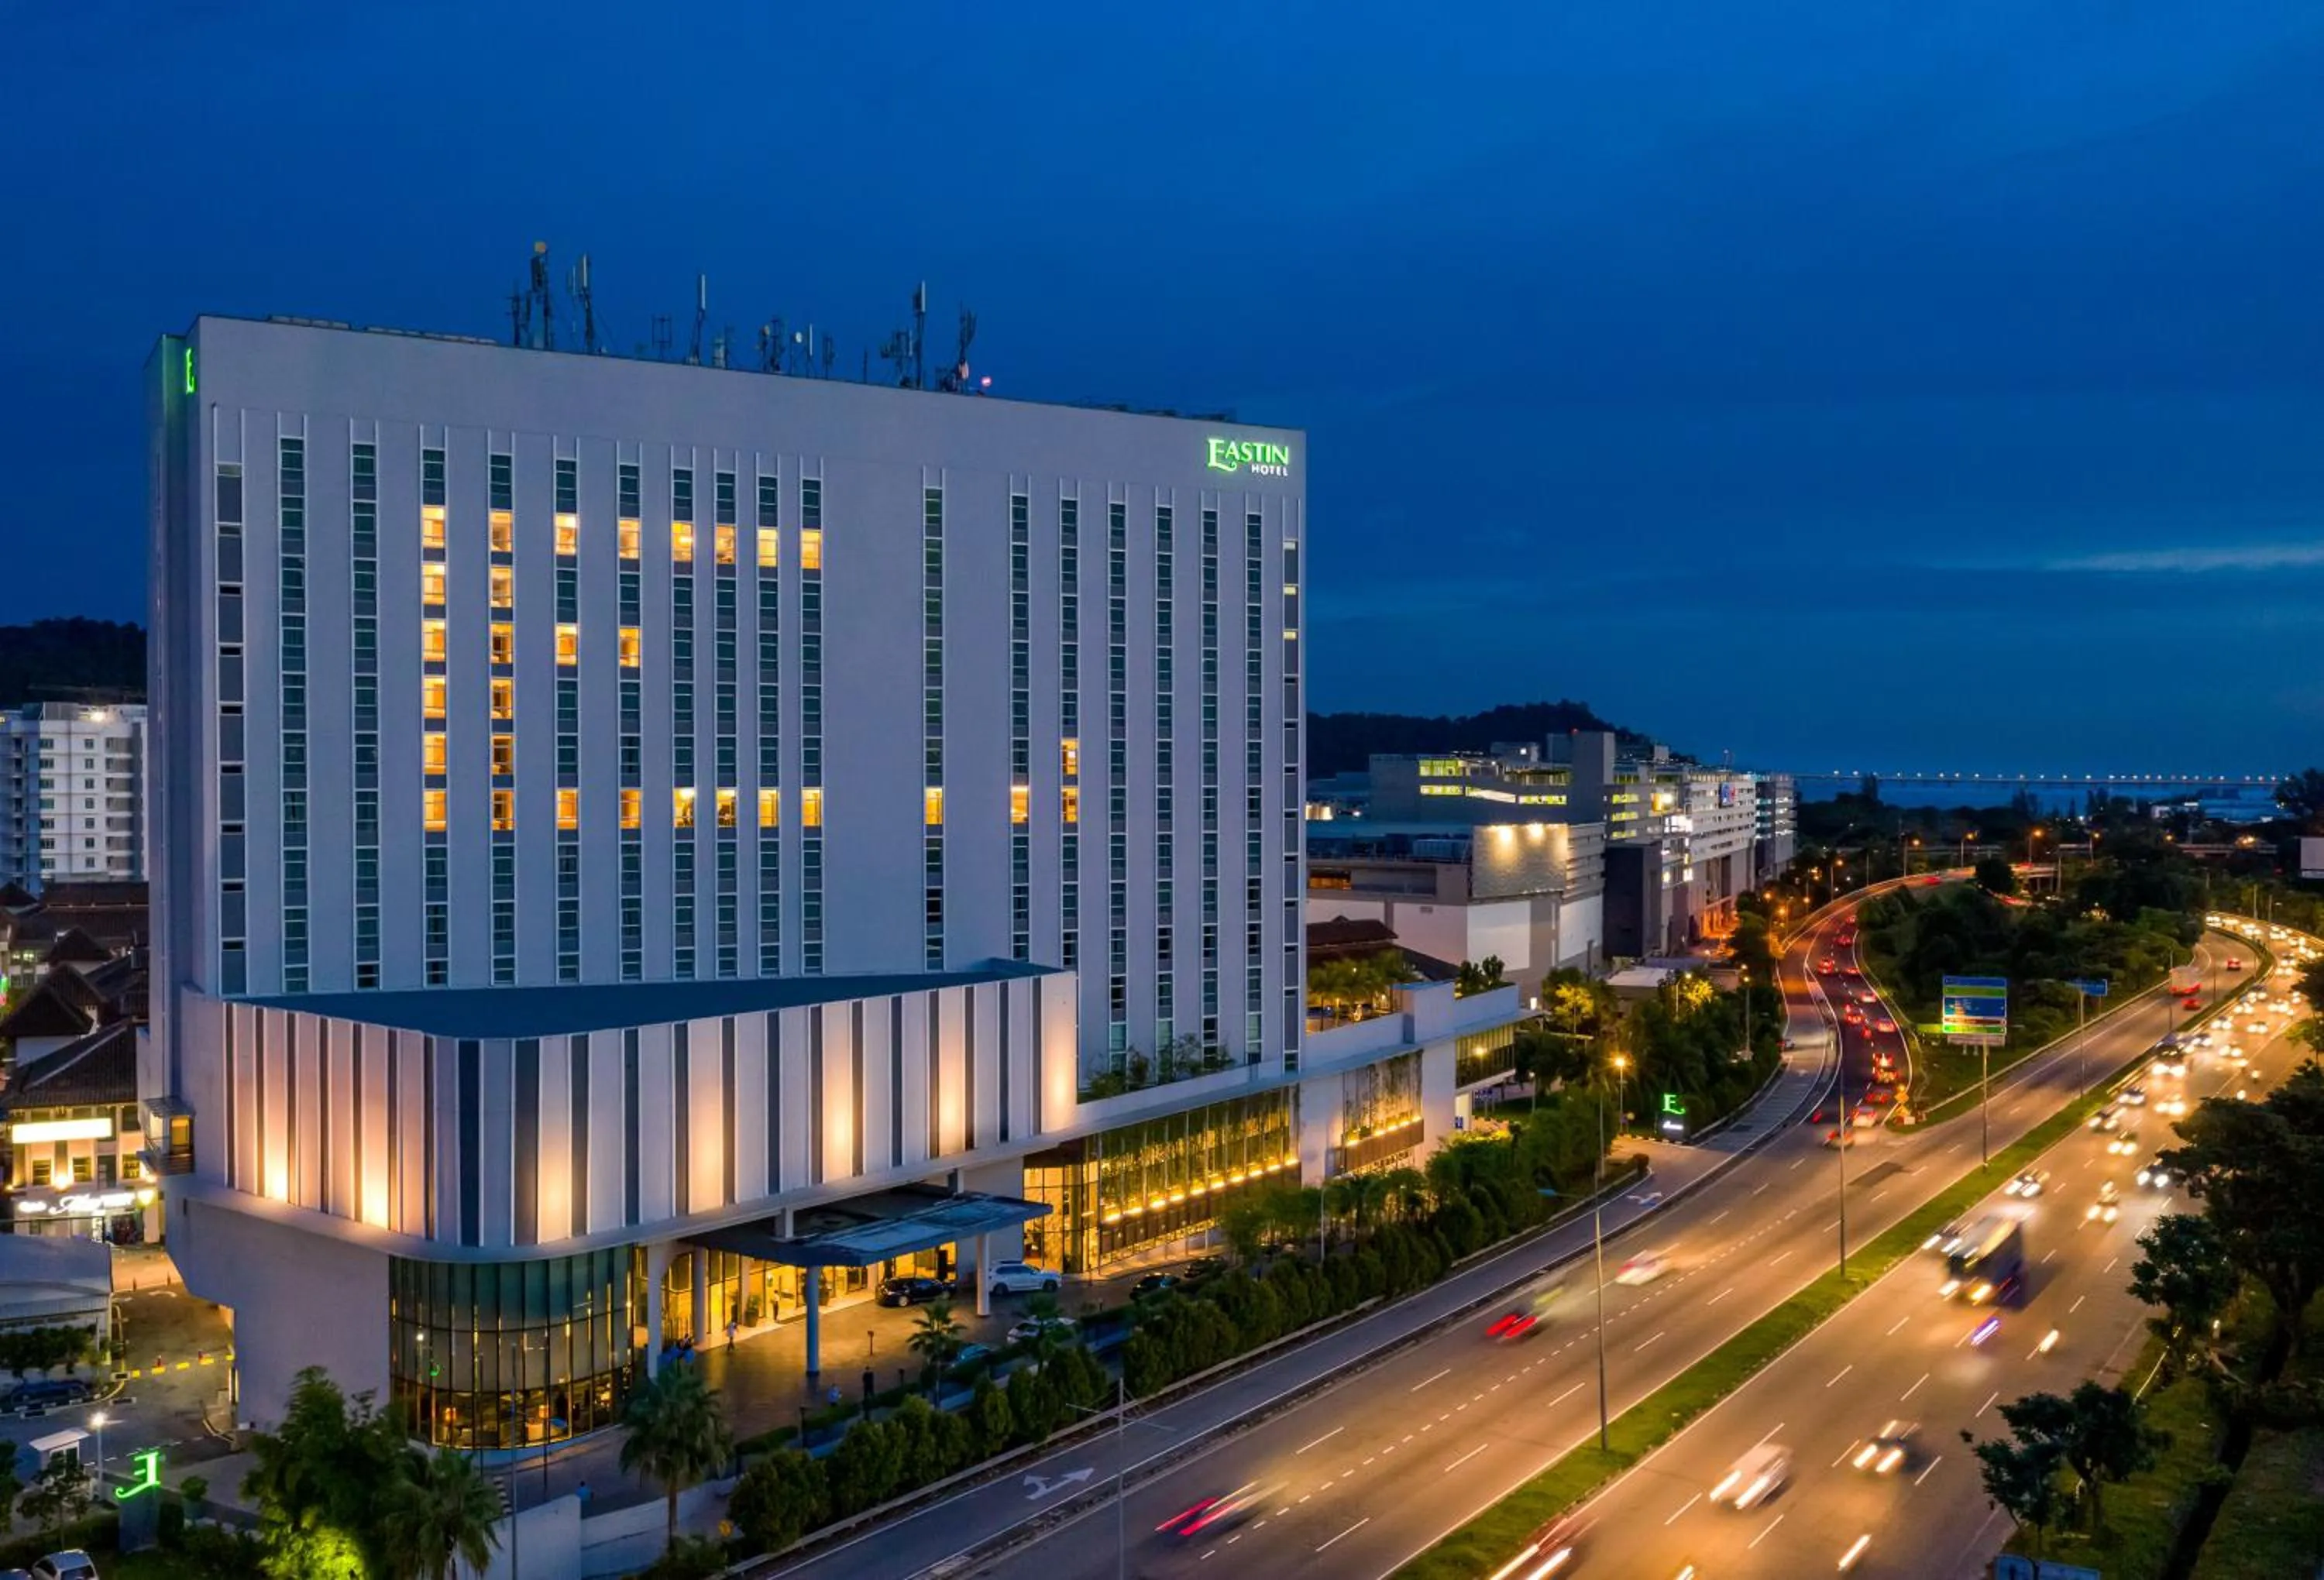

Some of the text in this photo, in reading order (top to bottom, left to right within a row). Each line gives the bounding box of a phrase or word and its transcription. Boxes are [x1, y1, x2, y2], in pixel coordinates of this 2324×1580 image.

[1208, 438, 1289, 472] EASTIN
[1251, 464, 1289, 477] HOTEL
[1662, 1093, 1686, 1115] E
